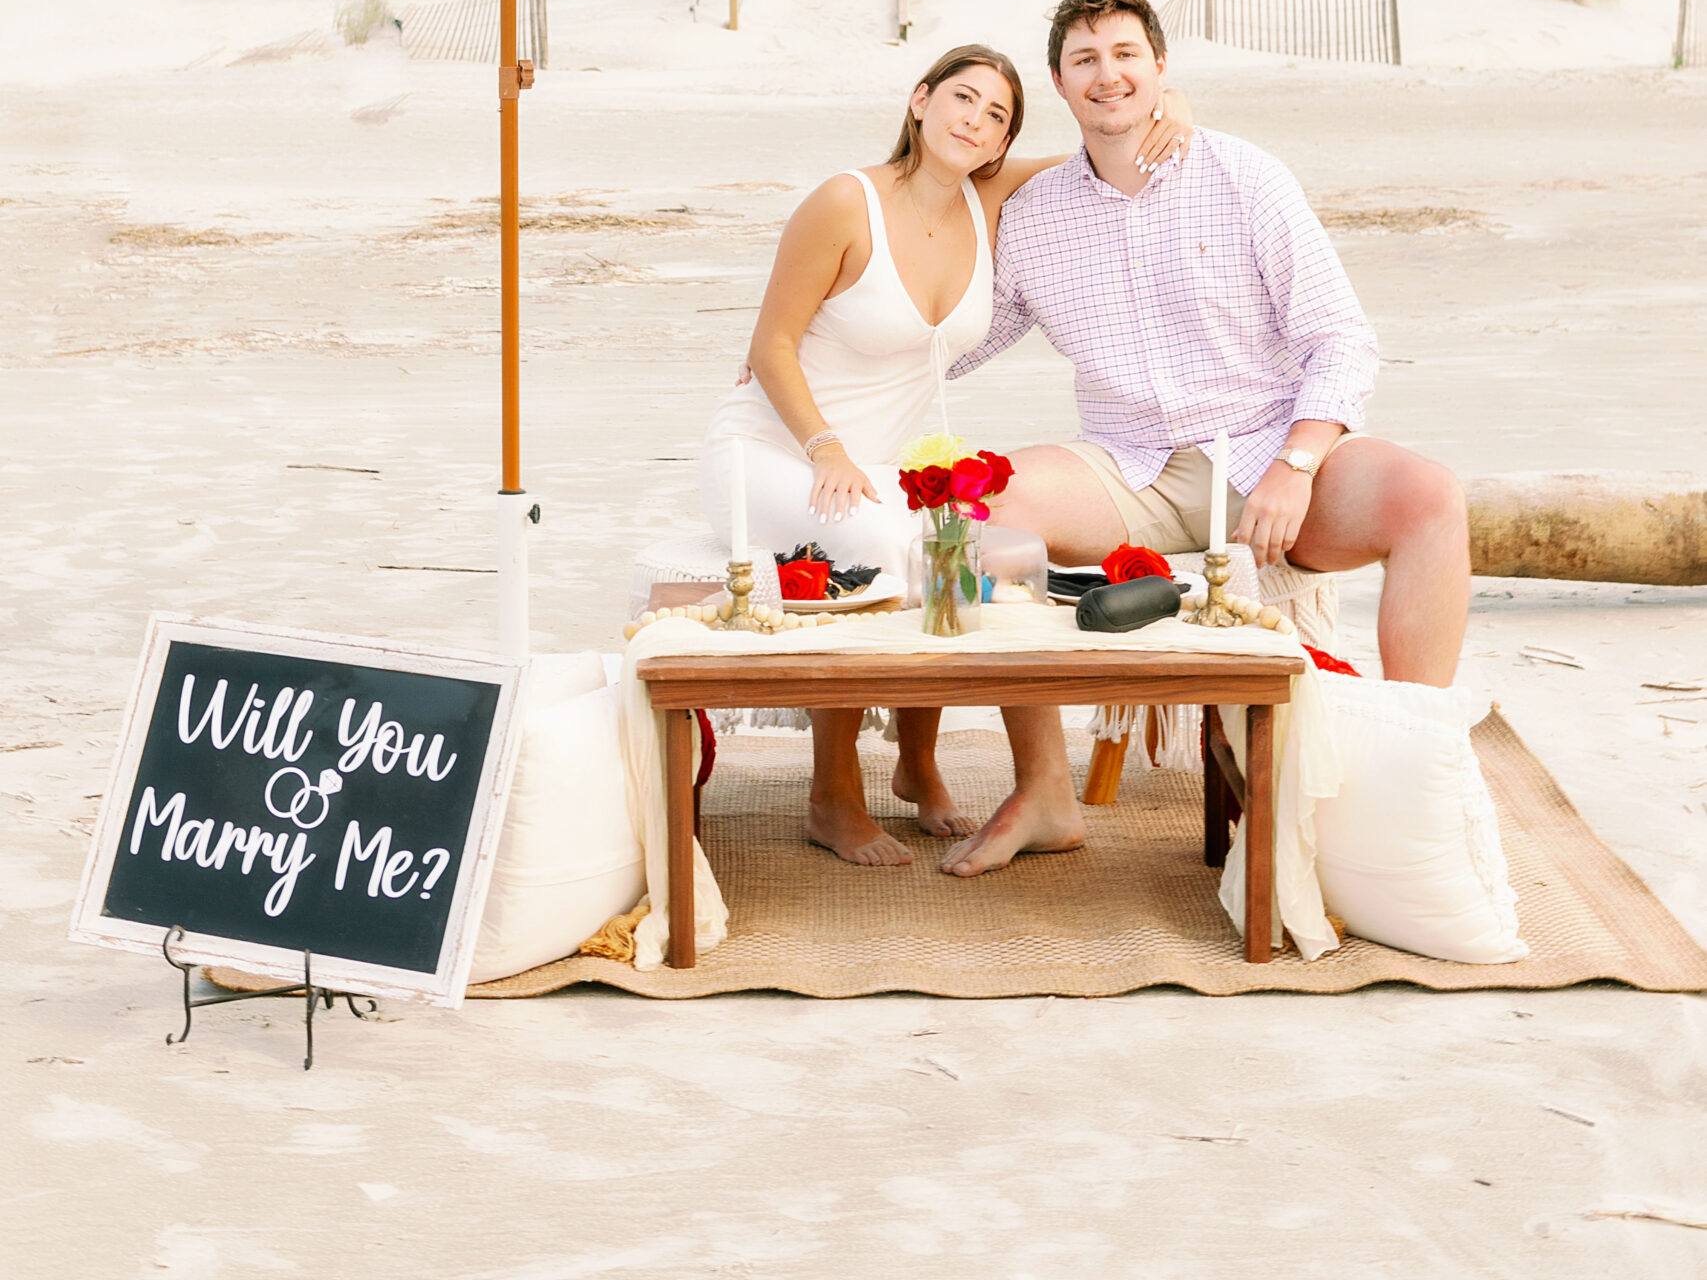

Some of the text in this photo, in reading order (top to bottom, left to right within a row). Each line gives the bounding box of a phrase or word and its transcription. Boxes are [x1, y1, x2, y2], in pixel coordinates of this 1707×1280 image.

[178, 674, 457, 781] Will You
[130, 787, 451, 917] Marry Me?
